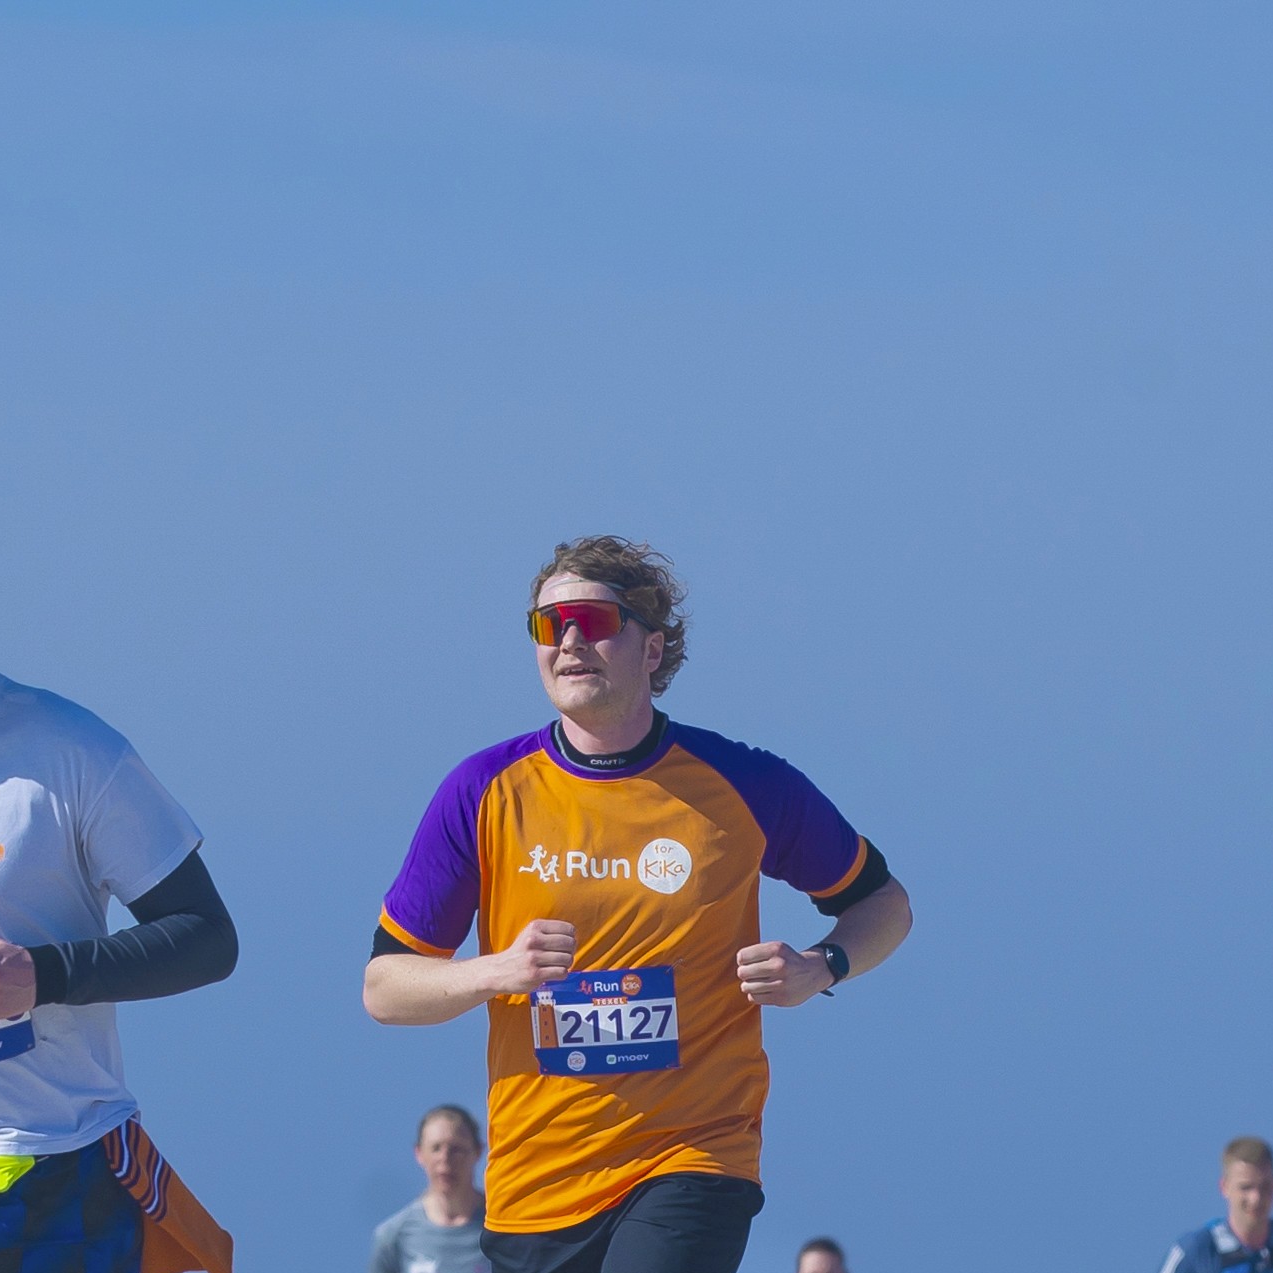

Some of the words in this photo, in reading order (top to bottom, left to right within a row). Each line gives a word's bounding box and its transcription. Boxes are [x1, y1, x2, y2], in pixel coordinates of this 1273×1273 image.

[590, 758, 618, 766] CRAFT
[654, 843, 674, 855] for
[566, 850, 631, 879] Run
[644, 858, 686, 879] KiKa
[594, 981, 619, 992] Run
[560, 1004, 673, 1045] 21127
[617, 1053, 650, 1063] moev
